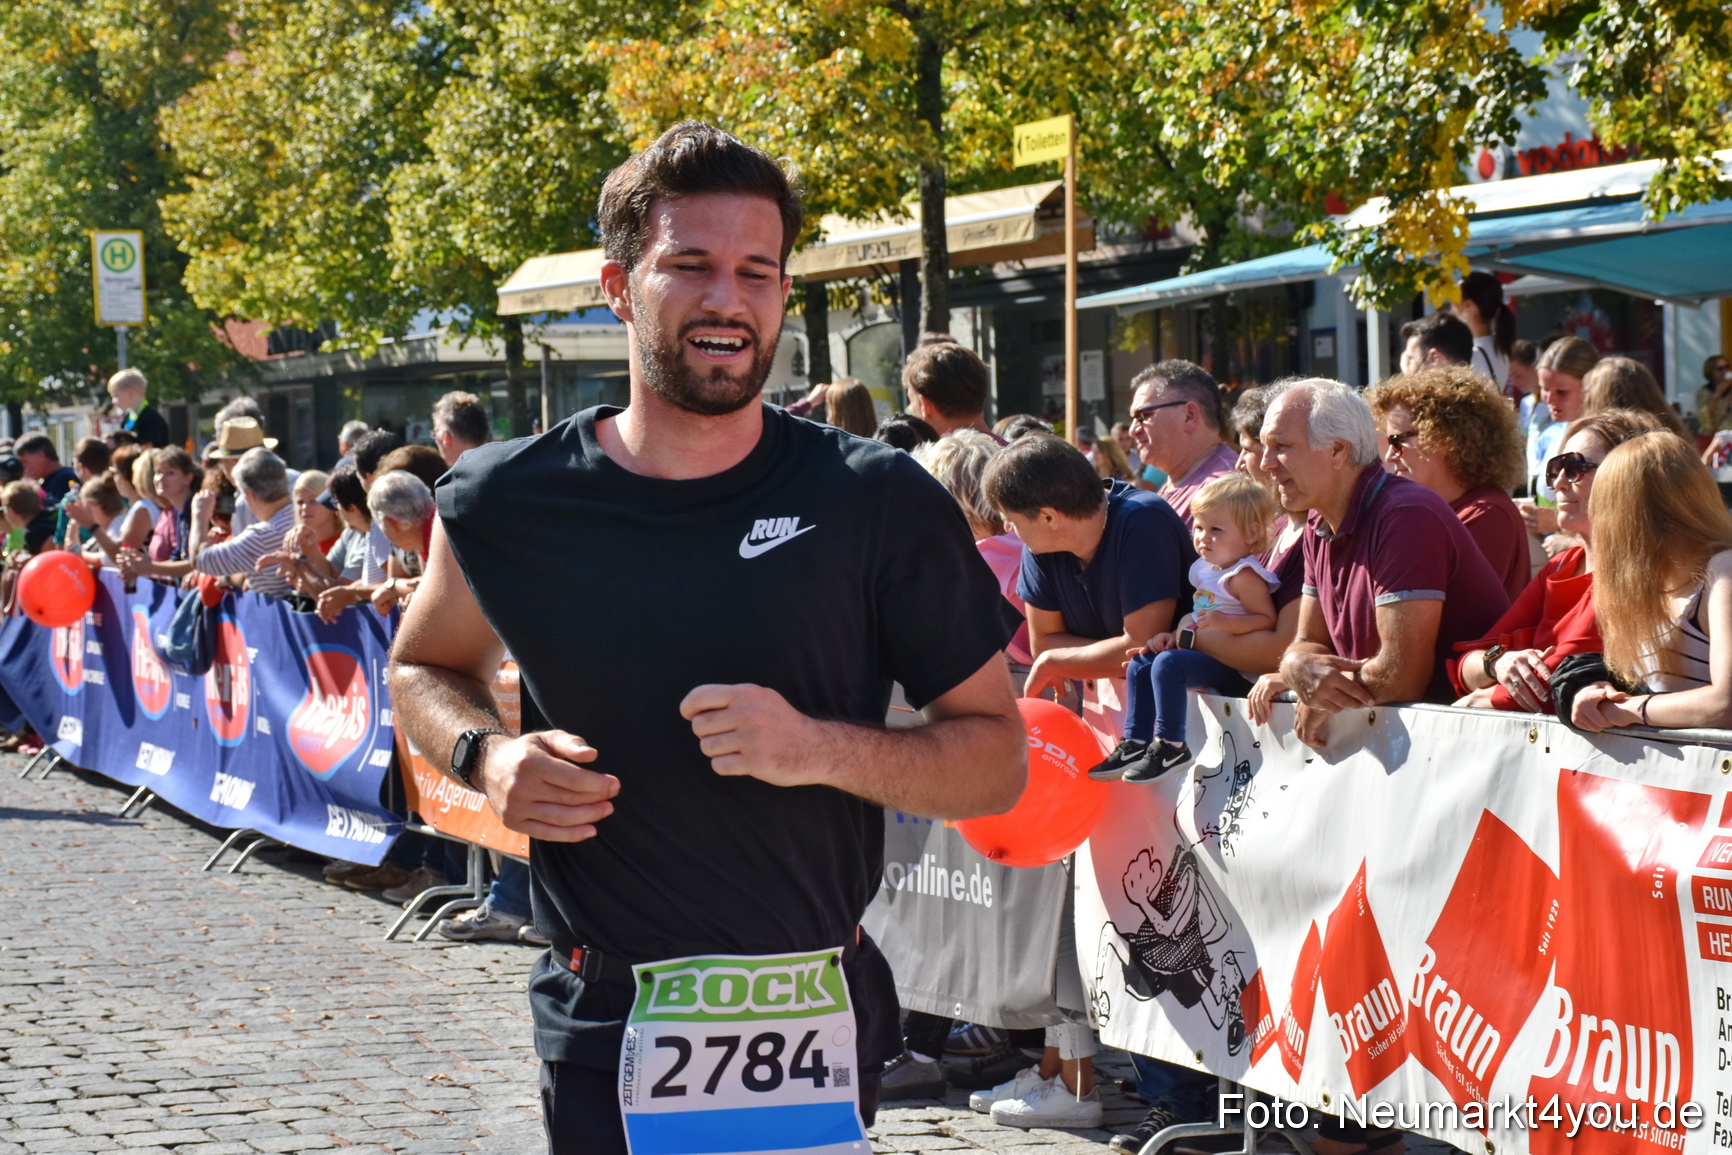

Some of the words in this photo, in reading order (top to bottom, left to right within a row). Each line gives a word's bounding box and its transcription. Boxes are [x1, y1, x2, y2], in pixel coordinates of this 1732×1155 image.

[1025, 132, 1067, 152] Toiletten
[750, 517, 800, 540] RUN
[1041, 753, 1078, 779] energie
[414, 768, 488, 813] tivAgentur
[1652, 866, 1666, 899] Seit
[1538, 931, 1551, 956] Seit
[1546, 898, 1560, 930] 1929
[1708, 931, 1732, 957] HE
[646, 959, 837, 1015] BOCK
[1330, 977, 1401, 1063] Braun
[1407, 942, 1501, 1082] Braun
[651, 1030, 830, 1099] 2784
[1367, 1039, 1390, 1060] Sicher
[1436, 1040, 1455, 1075] Sicher
[1455, 1066, 1465, 1087] ist
[1531, 985, 1682, 1106] Braun
